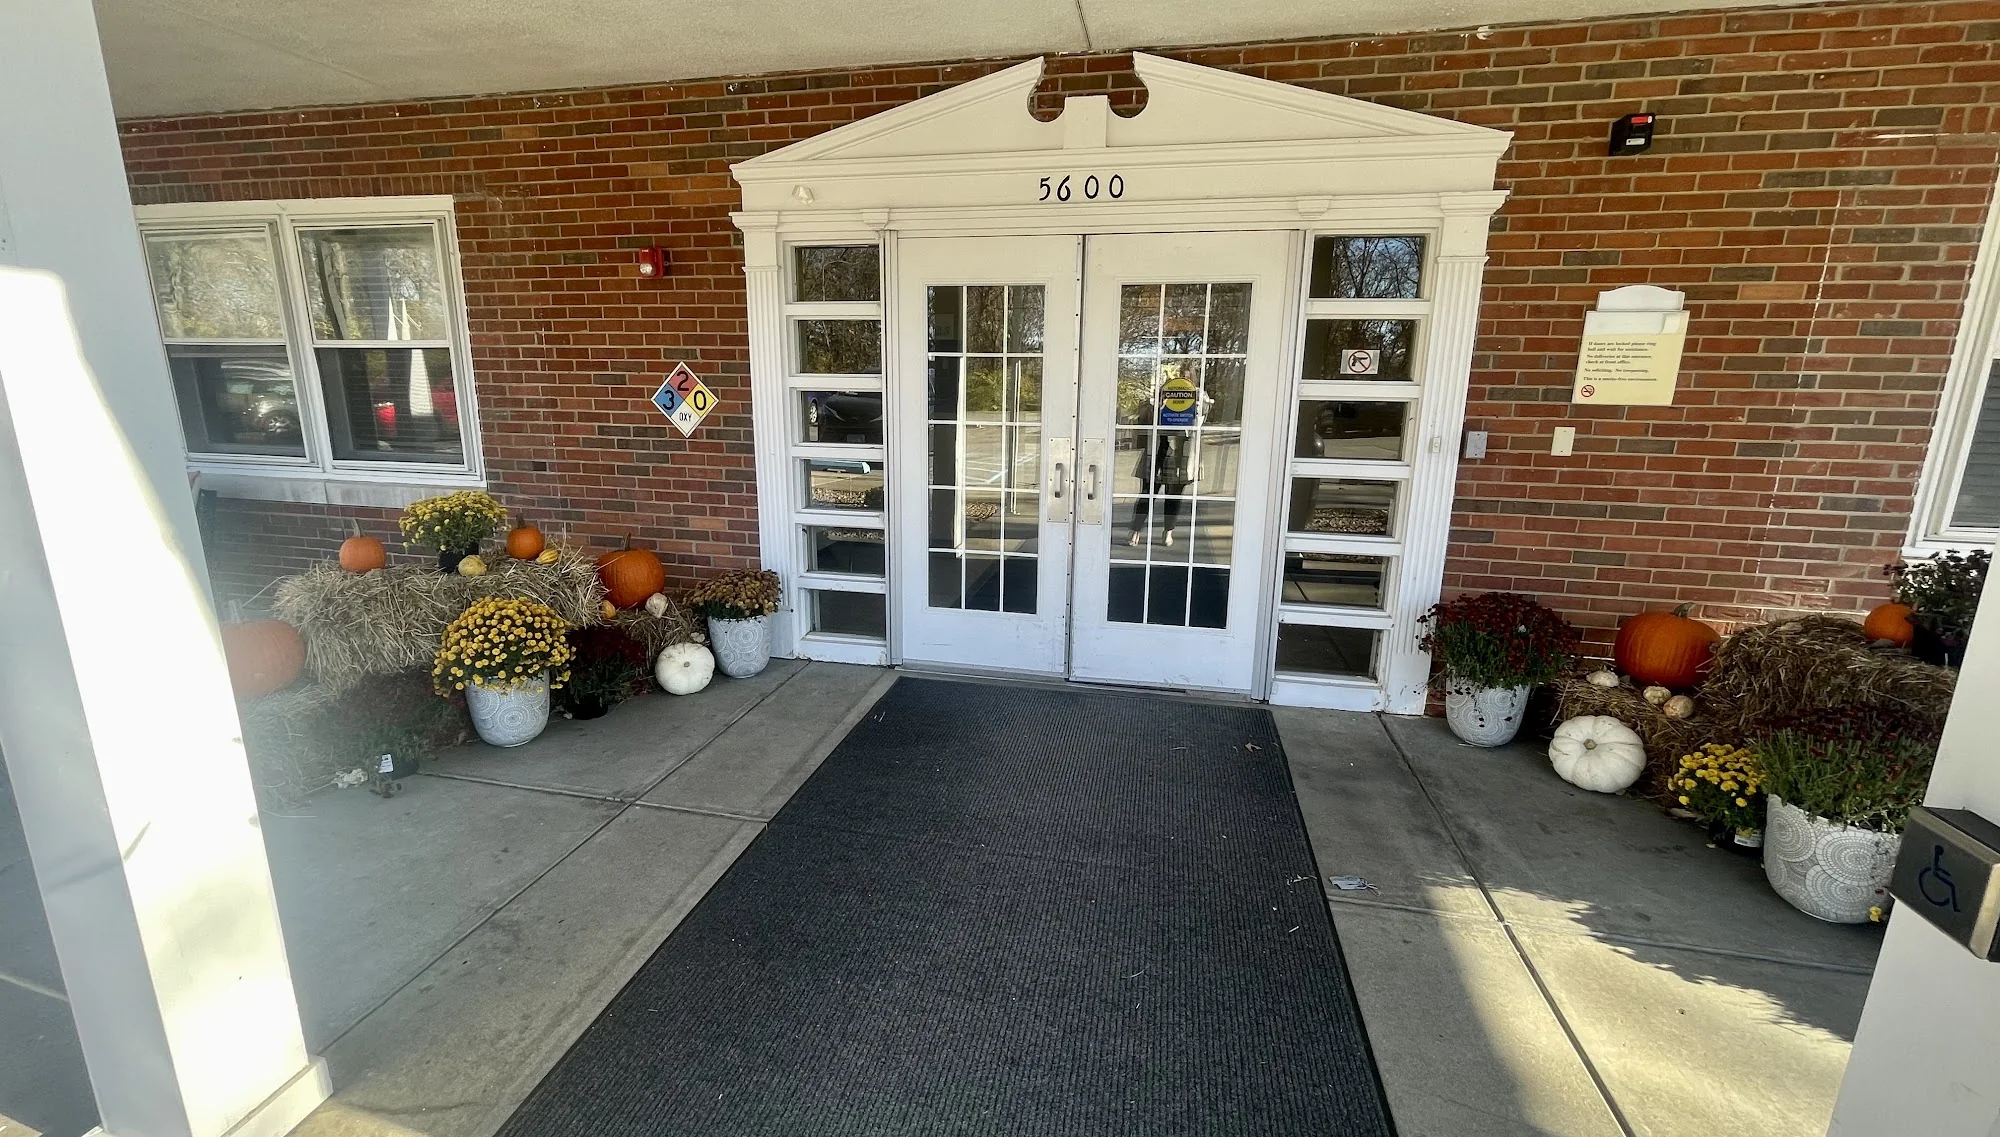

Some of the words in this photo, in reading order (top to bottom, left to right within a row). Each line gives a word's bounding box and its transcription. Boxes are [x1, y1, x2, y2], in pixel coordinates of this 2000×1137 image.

[1039, 174, 1124, 201] 5600
[677, 371, 689, 391] 2
[663, 390, 674, 410] 3
[694, 390, 706, 411] 0
[679, 412, 692, 422] OXY
